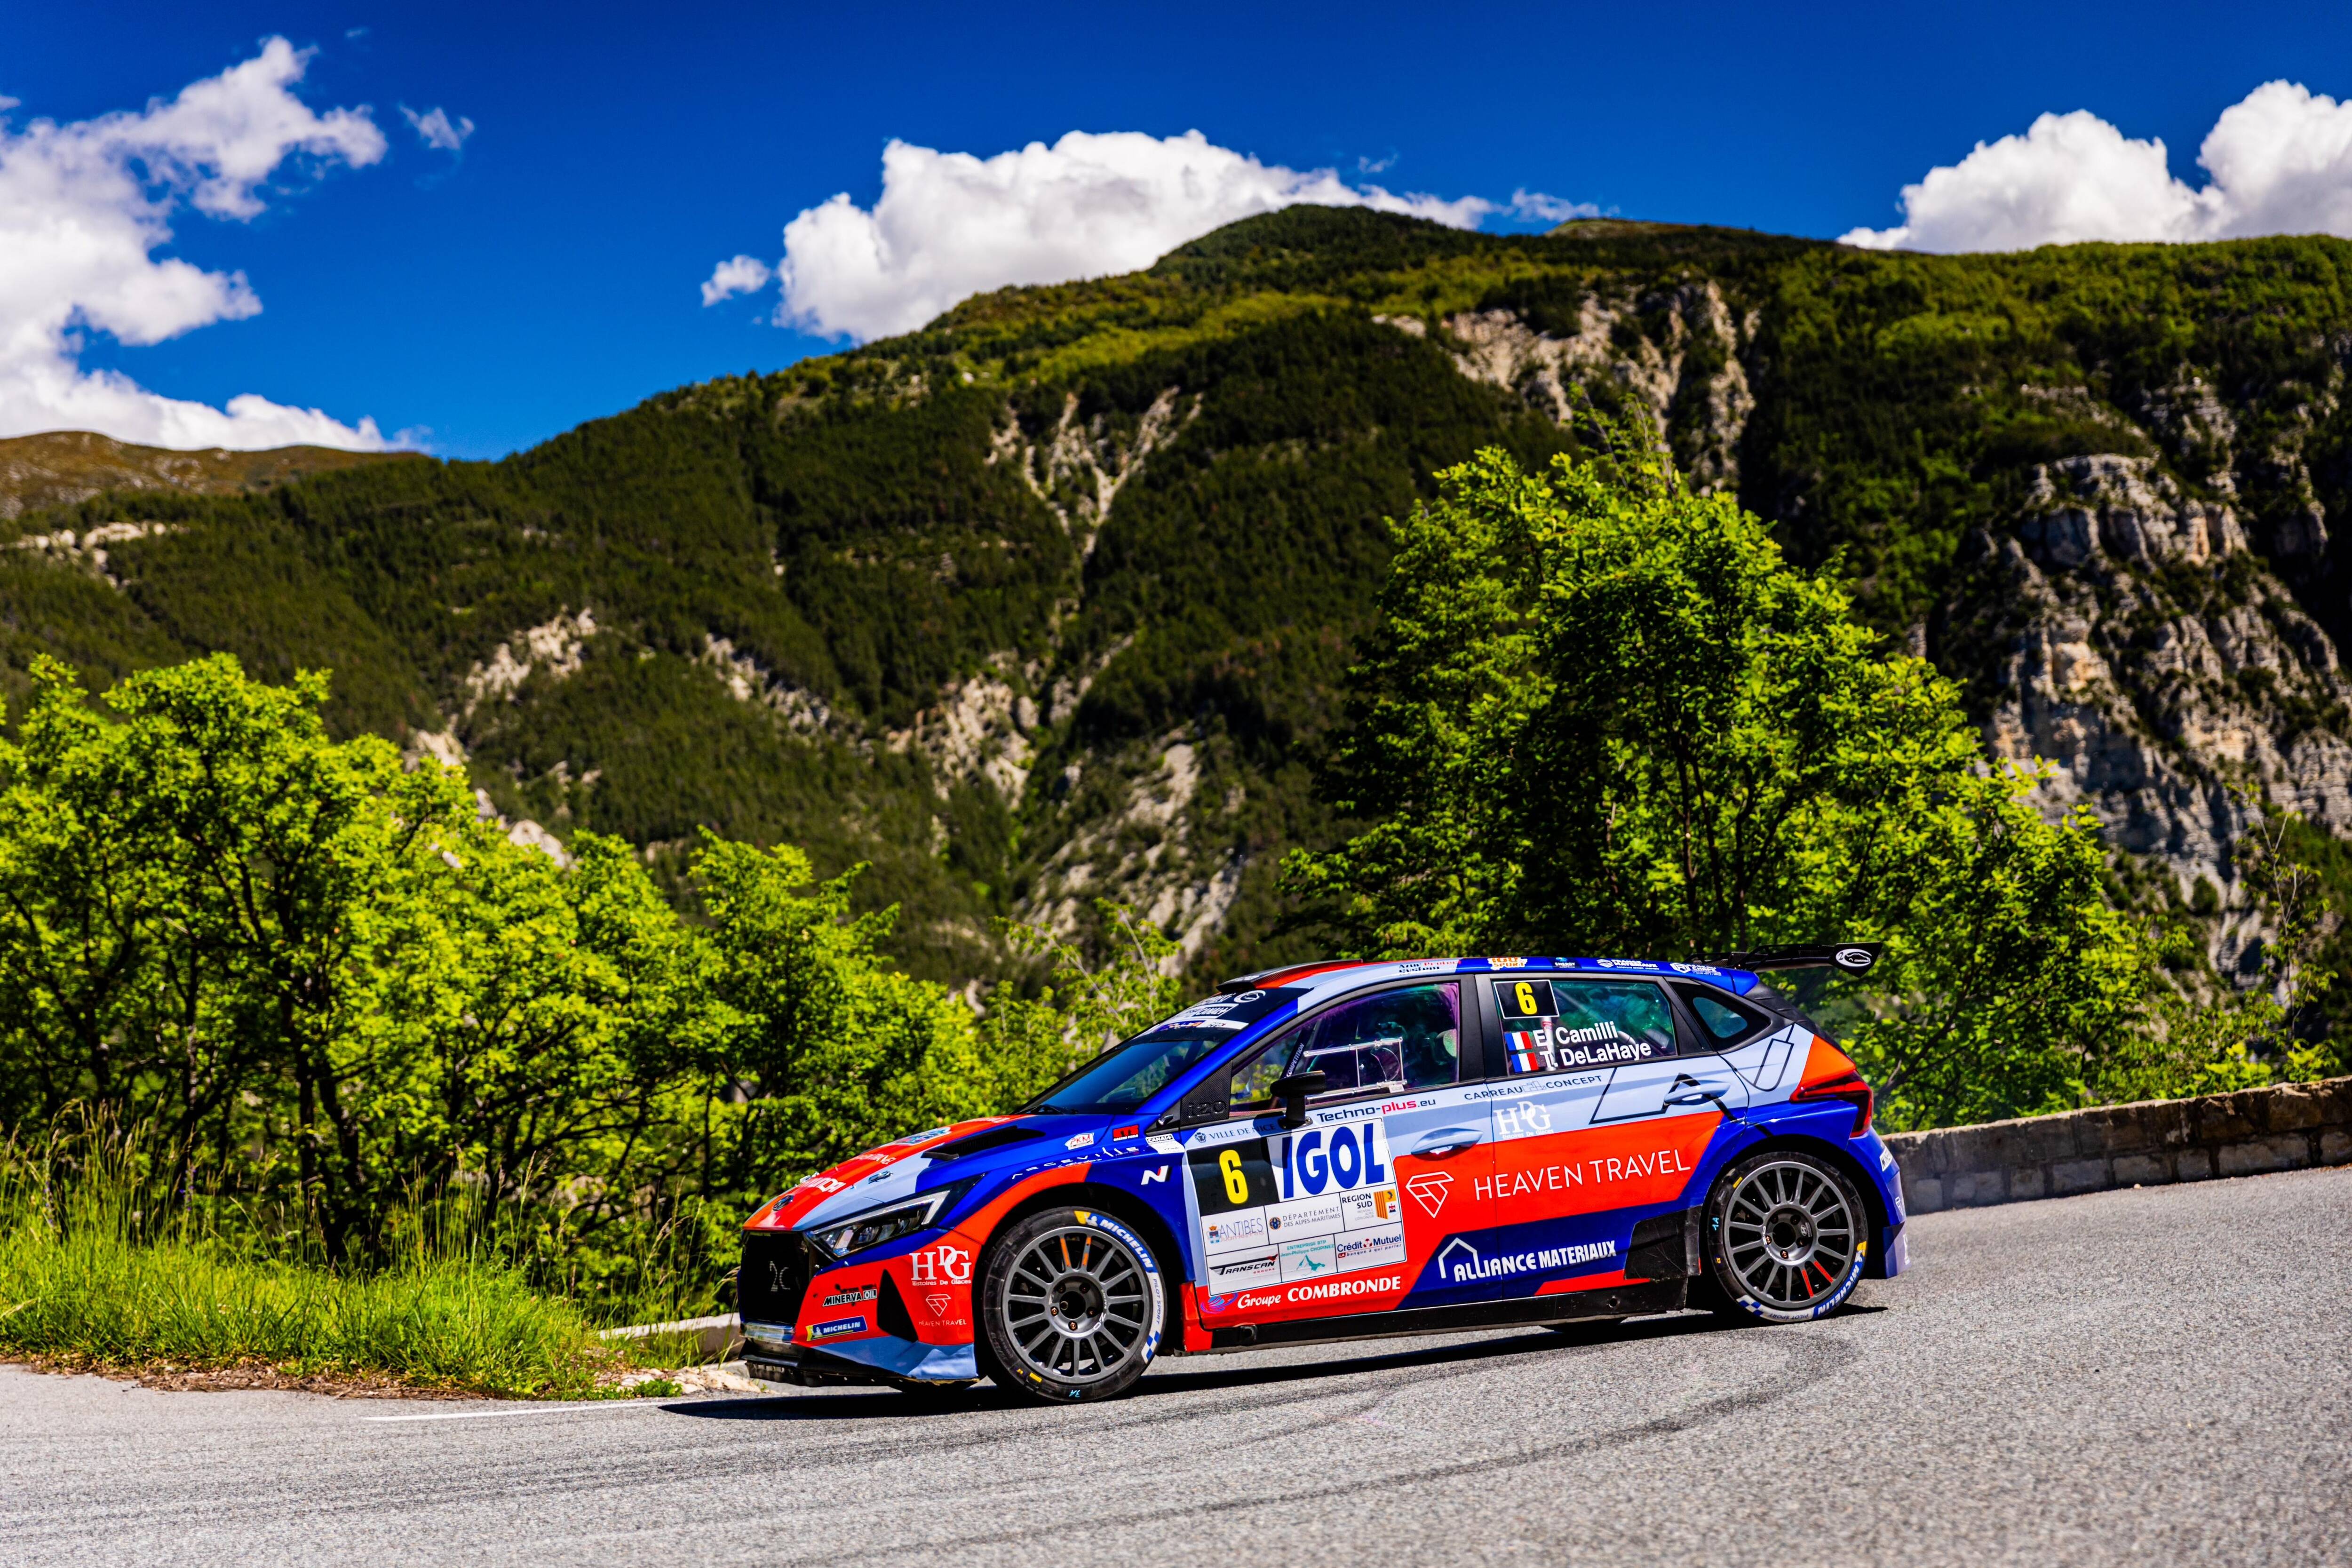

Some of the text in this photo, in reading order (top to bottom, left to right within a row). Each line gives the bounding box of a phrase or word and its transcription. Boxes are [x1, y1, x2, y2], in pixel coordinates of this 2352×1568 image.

[1515, 982, 1537, 1015] 6
[1555, 1021, 1618, 1044] Camilli
[1540, 1043, 1651, 1068] T. DeLaHaye
[1464, 1075, 1602, 1100] CARREAU CONCEPT
[1317, 1098, 1436, 1122] Techno-plus.eu
[1209, 1130, 1235, 1139] VILLE
[1253, 1123, 1275, 1133] NICE
[1282, 1122, 1384, 1199] IGOL
[1219, 1149, 1249, 1204] 6
[1474, 1149, 1691, 1201] HEAVEN TRAVEL
[1357, 1201, 1373, 1209] SUD
[1219, 1218, 1263, 1239] ANTIBES
[1100, 1219, 1153, 1267] MICHELIN
[1287, 1241, 1316, 1250] ENTREPRISE
[1337, 1234, 1401, 1252] Crédit Mutuel
[909, 1246, 972, 1280] HDG
[1219, 1261, 1275, 1275] TRANSCAN
[1454, 1240, 1616, 1282] ALLIANCE MATERIAUX
[823, 1289, 876, 1306] MINERVA OIL
[1237, 1276, 1401, 1309] Groupe COMBRONDE
[1818, 1264, 1859, 1315] MICHELIN
[823, 1322, 860, 1333] MICHELIN
